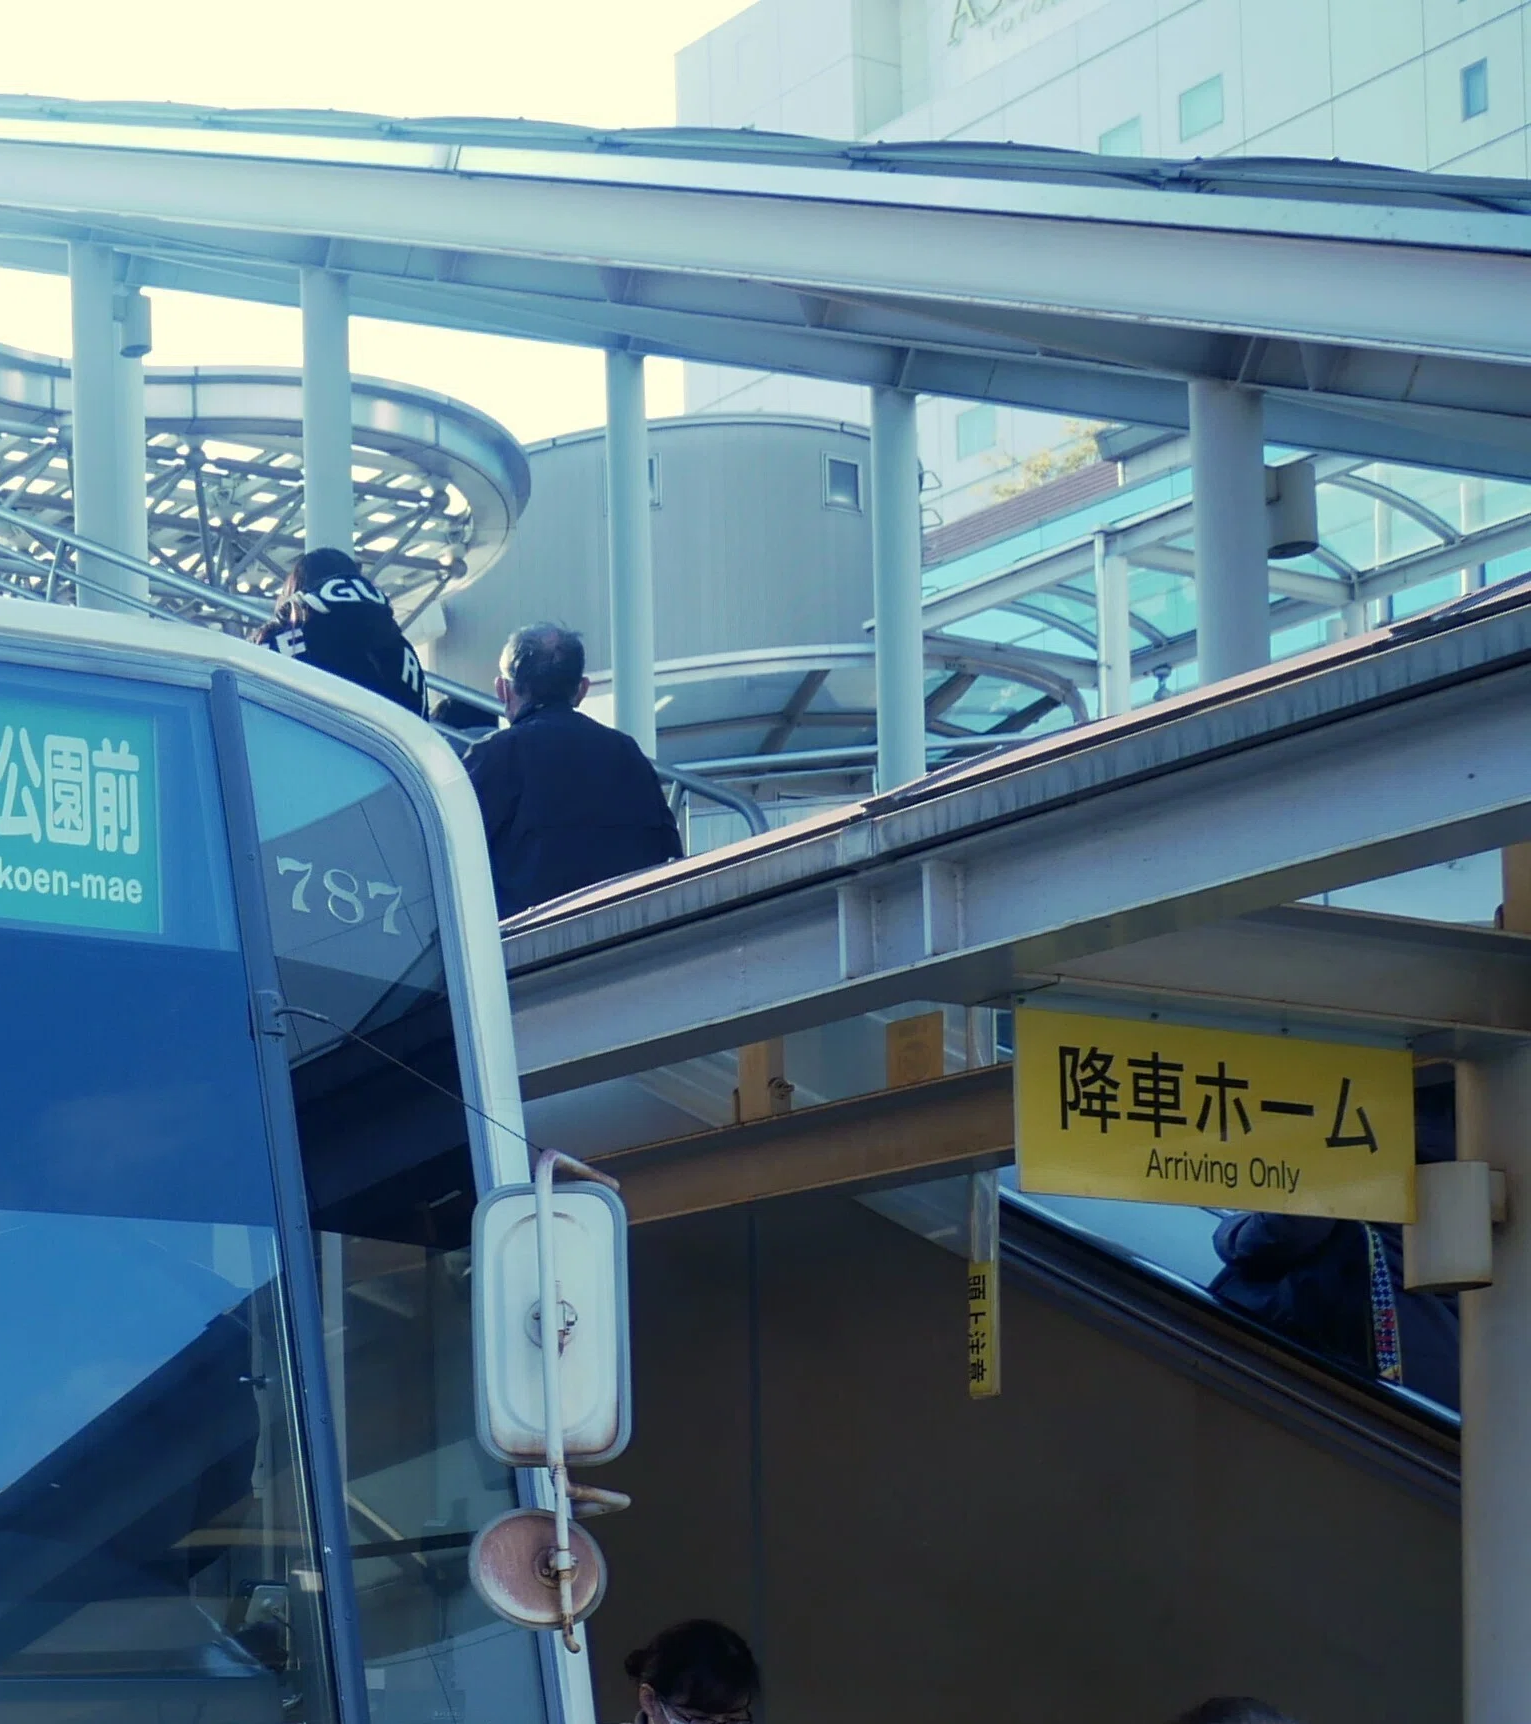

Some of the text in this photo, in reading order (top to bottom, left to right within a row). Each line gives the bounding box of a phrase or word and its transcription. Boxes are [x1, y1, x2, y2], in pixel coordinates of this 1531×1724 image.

[277, 856, 405, 937] 787
[1057, 1045, 1379, 1154] 降車ホーム
[1146, 1148, 1301, 1194] Arriving Only
